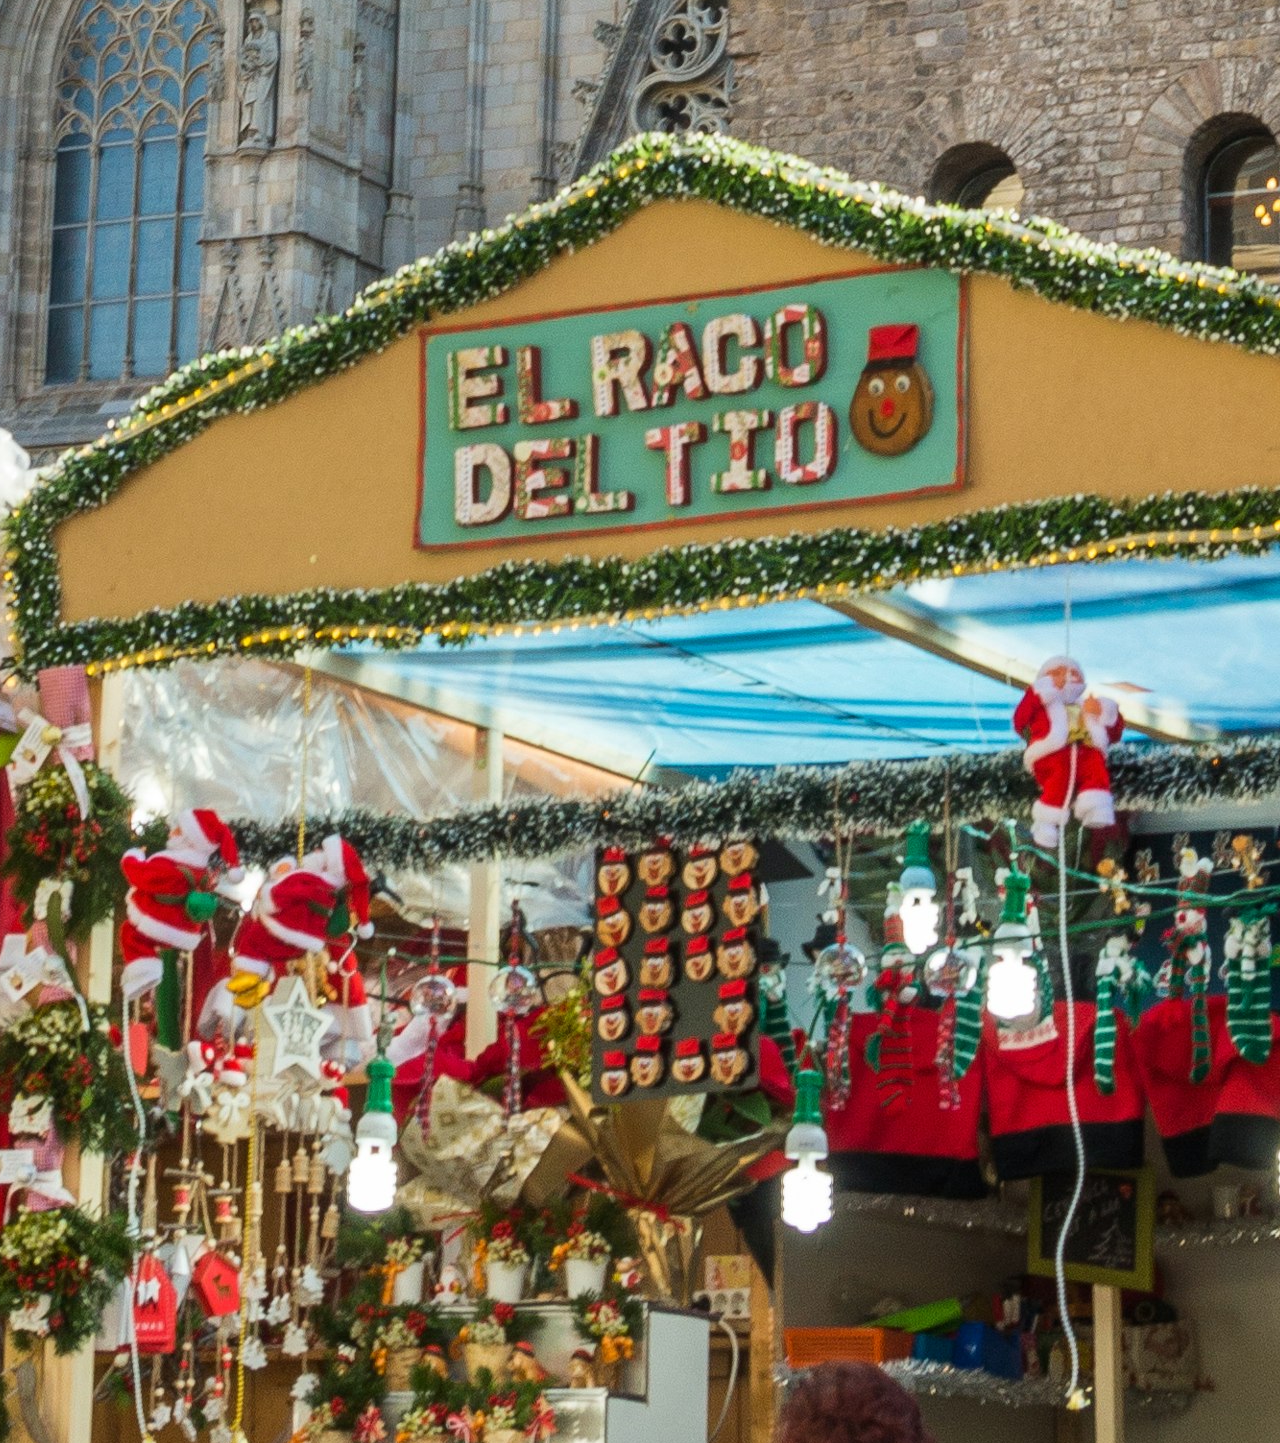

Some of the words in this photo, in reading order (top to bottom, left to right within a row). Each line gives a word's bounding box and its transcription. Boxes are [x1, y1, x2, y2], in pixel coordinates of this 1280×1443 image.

[447, 344, 578, 431] EL
[590, 303, 827, 417] RACO
[454, 433, 634, 527] DEL
[645, 401, 838, 507] TIO
